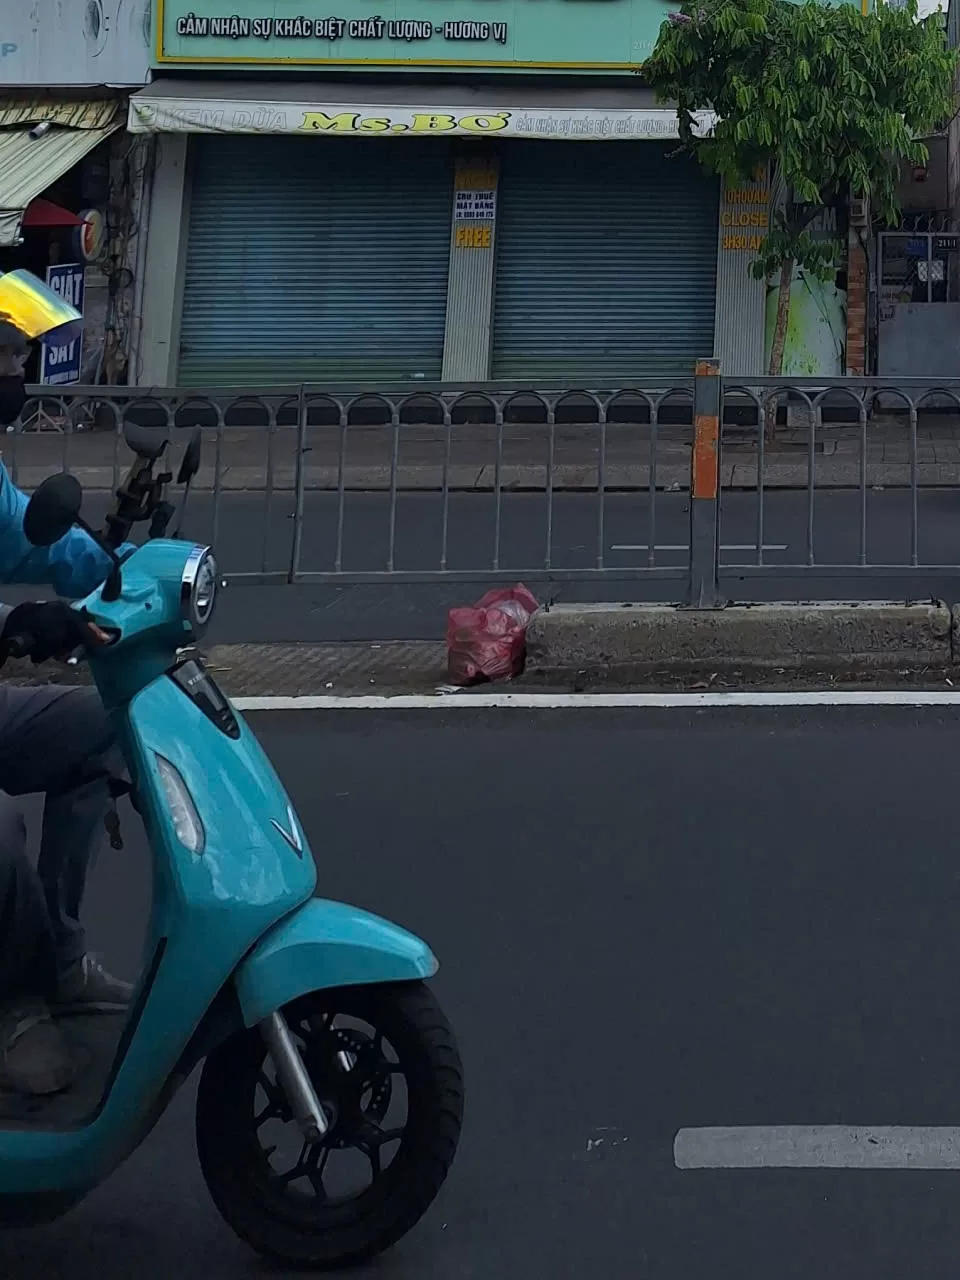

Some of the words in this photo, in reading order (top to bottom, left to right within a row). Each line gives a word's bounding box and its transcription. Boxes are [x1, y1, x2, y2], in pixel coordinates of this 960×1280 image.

[177, 13, 207, 35] CẢM
[210, 14, 250, 40] NHẬN
[253, 17, 272, 40] SỰ
[275, 16, 311, 37] KHÁC
[314, 16, 345, 41] BIỆT
[349, 15, 384, 38] CHẤT
[388, 19, 432, 42] LƯỢNG
[444, 20, 489, 40] HƯƠNG
[493, 22, 507, 43] VỊ
[721, 211, 768, 228] CLOSE
[456, 227, 491, 248] FREE
